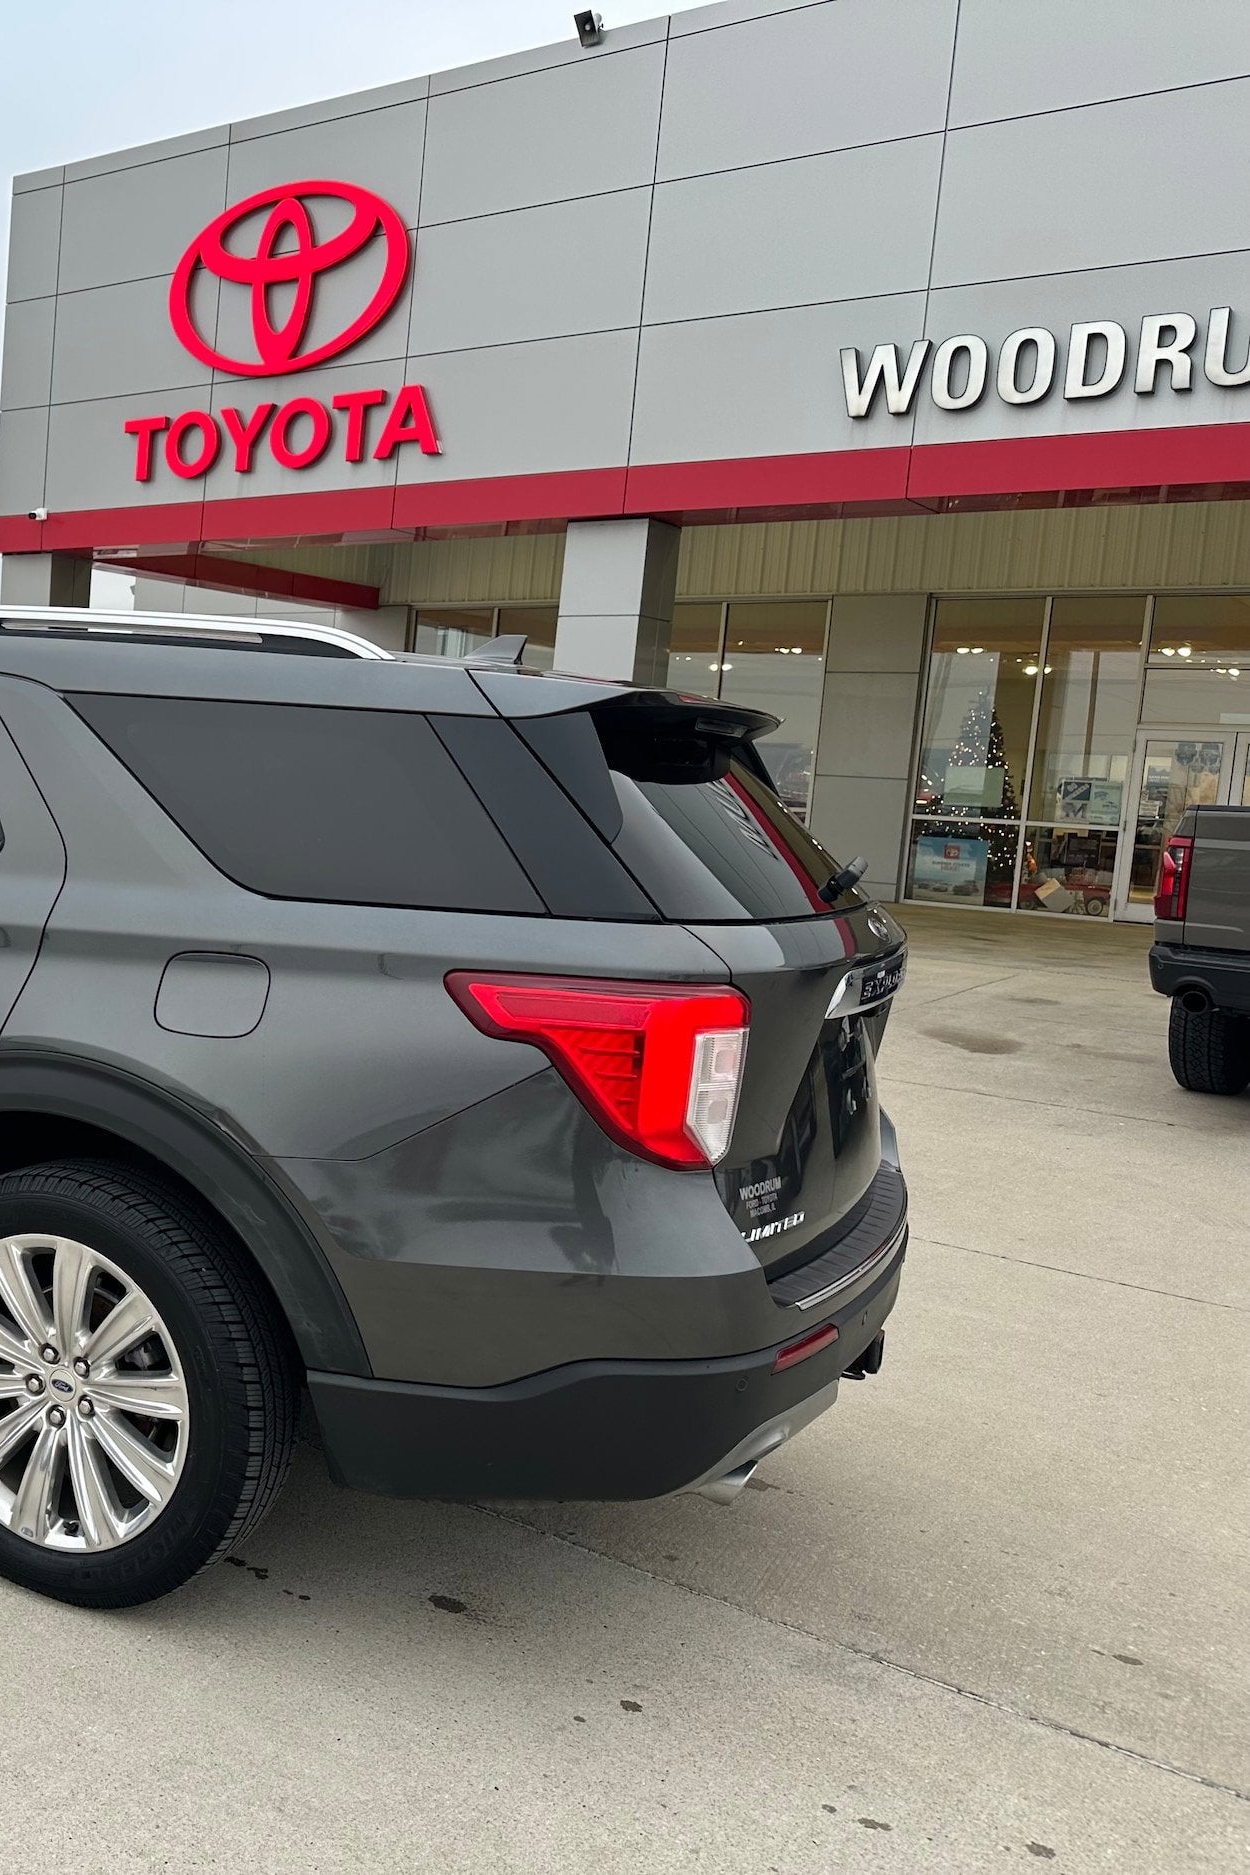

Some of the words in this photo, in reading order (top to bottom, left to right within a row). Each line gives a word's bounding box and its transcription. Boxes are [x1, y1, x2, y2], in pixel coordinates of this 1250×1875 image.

[839, 306, 1250, 420] WOODRU
[124, 384, 442, 482] TOYOTA
[739, 1176, 781, 1201] WOODRUM
